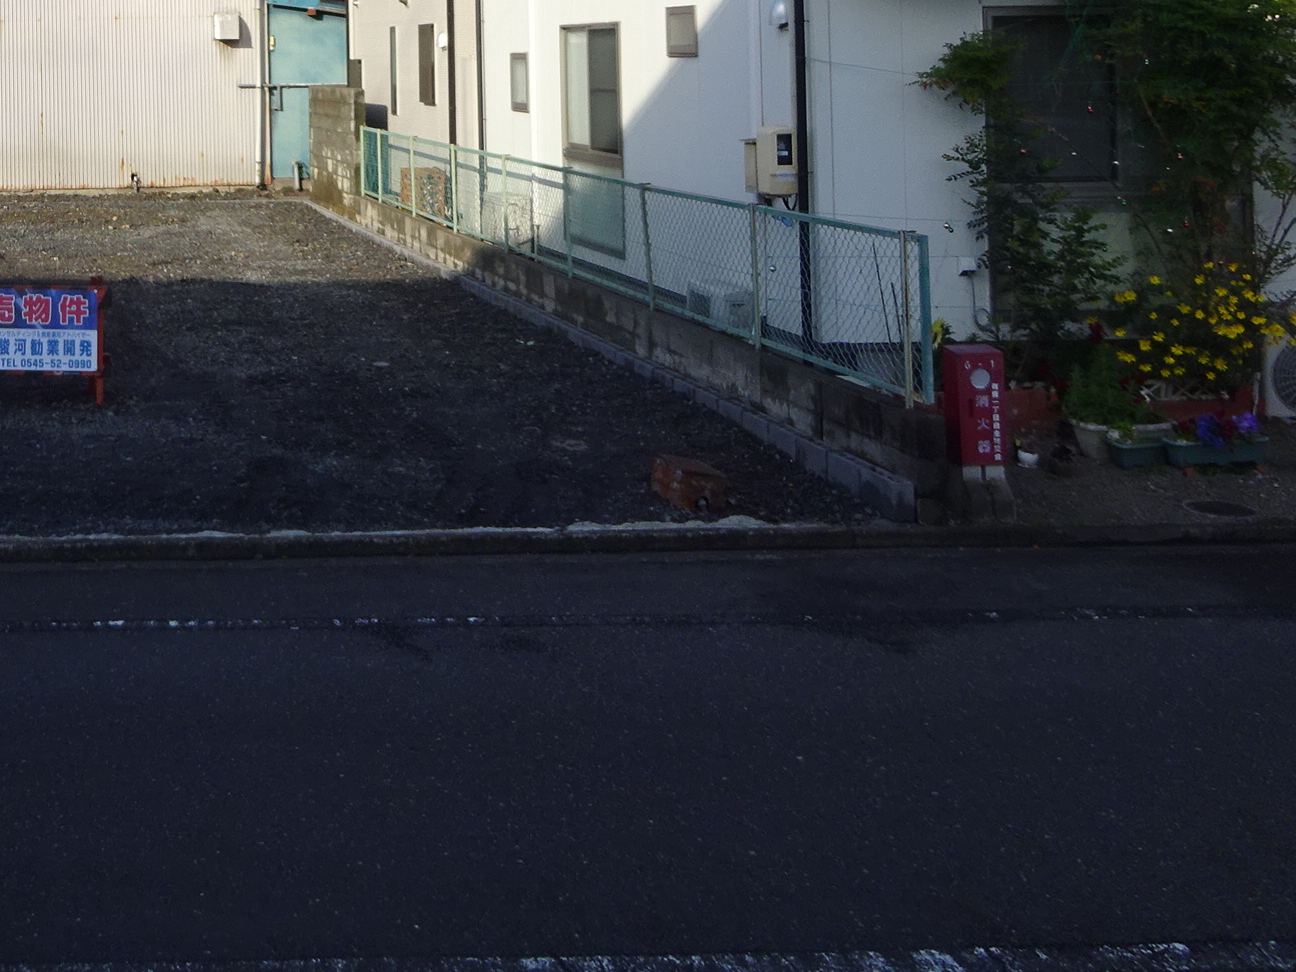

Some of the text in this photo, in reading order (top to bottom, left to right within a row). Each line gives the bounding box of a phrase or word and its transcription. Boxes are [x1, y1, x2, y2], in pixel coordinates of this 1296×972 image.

[1, 358, 17, 368] TEL
[21, 358, 92, 369] 0545-52-0990
[975, 394, 991, 454] 消火器
